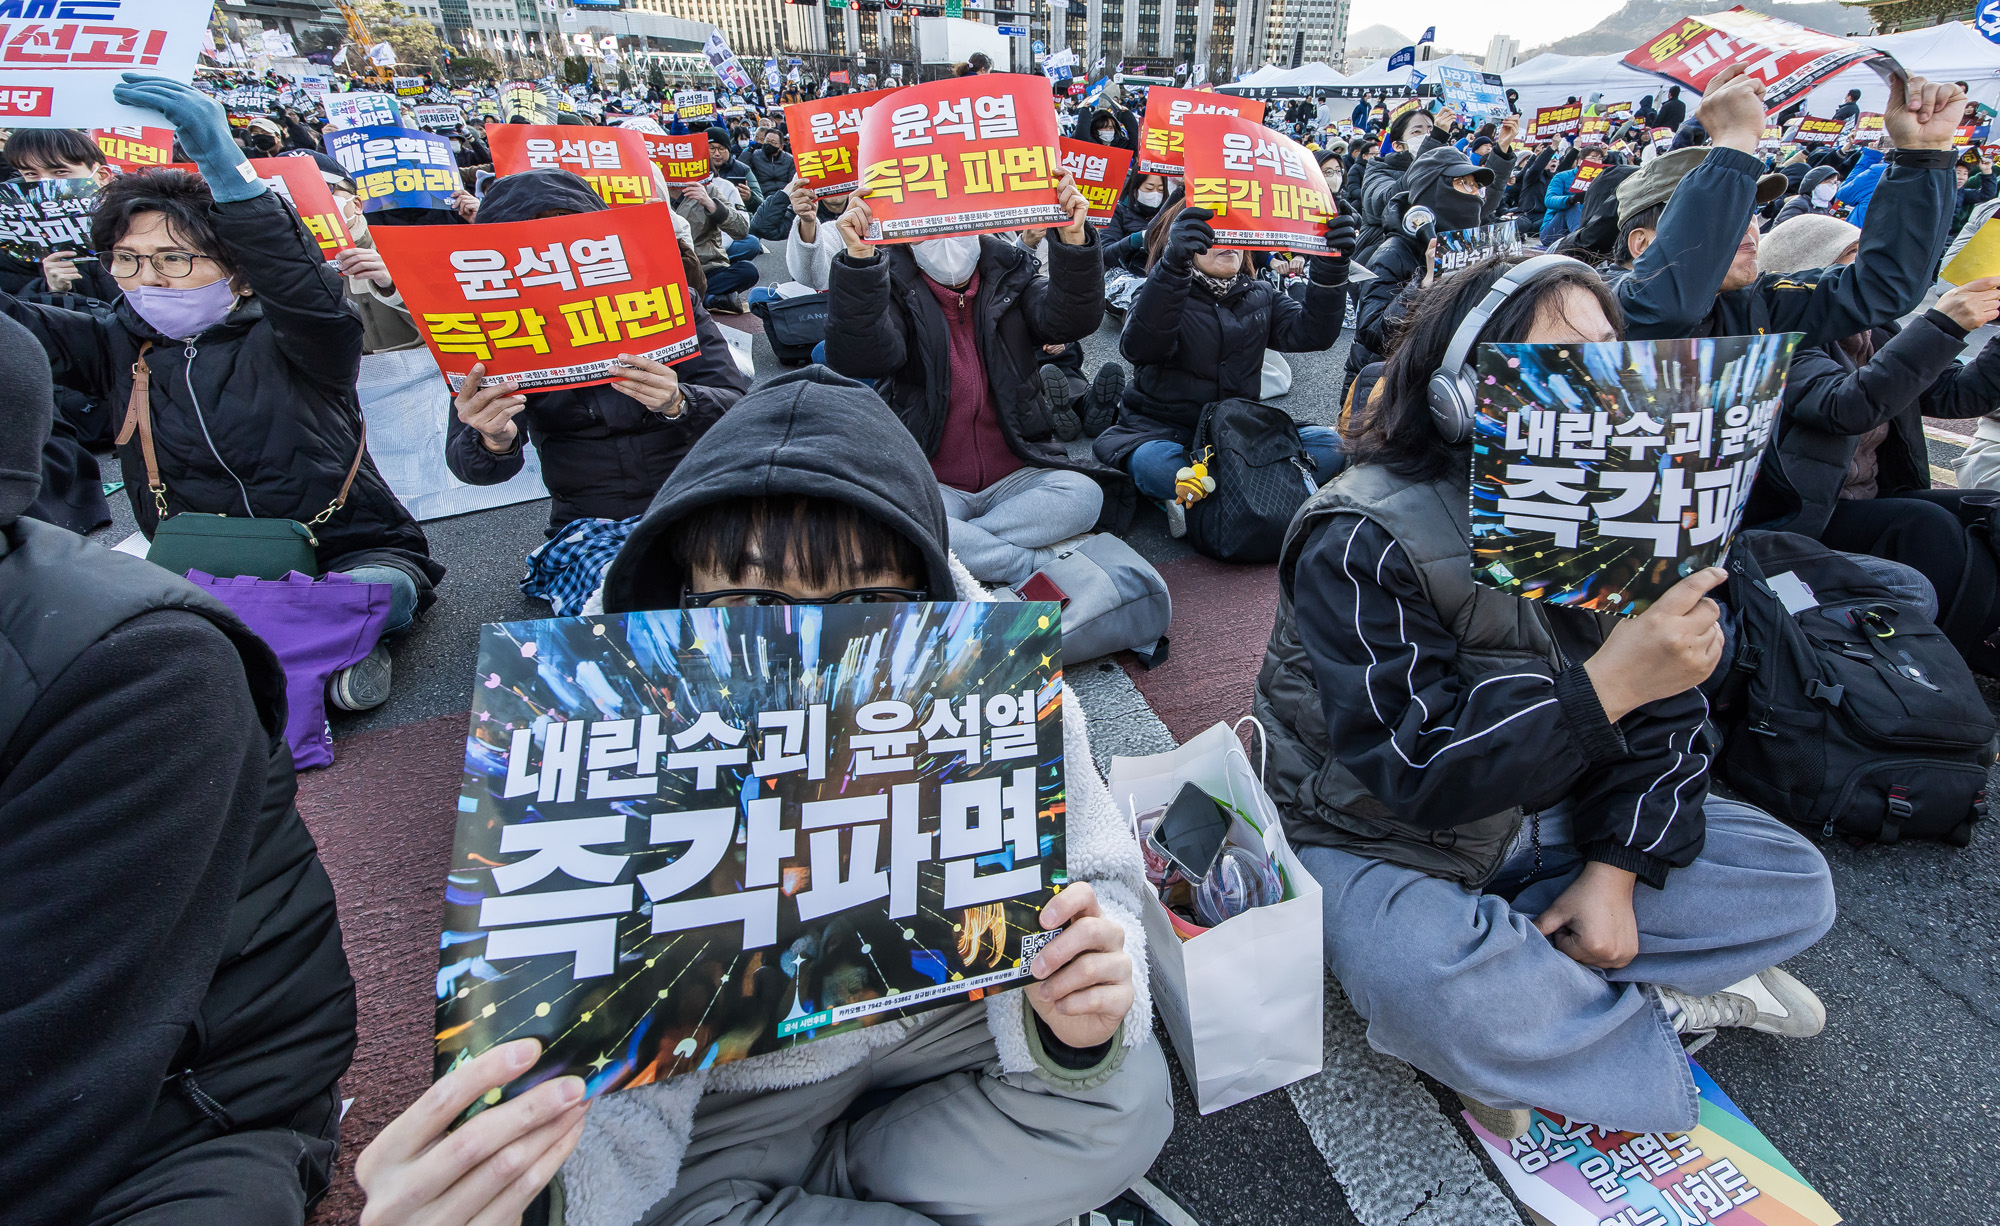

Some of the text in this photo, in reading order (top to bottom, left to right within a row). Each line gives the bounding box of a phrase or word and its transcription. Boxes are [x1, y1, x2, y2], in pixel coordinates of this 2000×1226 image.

[0, 24, 168, 66] 선고!
[1440, 67, 1472, 82] 나라가
[329, 99, 354, 108] 내란수괴
[330, 106, 357, 117] 윤석열
[355, 95, 390, 112] 즉각
[361, 109, 395, 126] 파면
[419, 113, 459, 124] 해체하라
[891, 94, 1019, 149] 윤석열
[332, 132, 369, 149] 한덕수는
[810, 107, 865, 144] 윤석
[525, 138, 622, 170] 윤석열
[669, 158, 708, 179] 파면!
[797, 146, 853, 180] 즉각
[1059, 151, 1109, 183] 석열
[1222, 133, 1308, 182] 윤석열
[863, 146, 1059, 203] 즉각 파면!
[1193, 177, 1336, 226] 즉각 파면!
[450, 235, 632, 300] 윤석열
[422, 283, 686, 361] 즉각 파면!
[506, 373, 523, 382] 파면
[524, 370, 549, 380] 국힘당
[550, 368, 566, 377] 해산
[655, 345, 677, 358] 모이자!
[1505, 398, 1775, 461] 내란수괴 윤석열
[1497, 448, 1765, 558] 즉각파면
[503, 689, 1039, 803] 내란수괴 윤석열
[478, 767, 1043, 981] 즉각파면
[799, 1013, 827, 1028] 시민후원
[838, 1005, 867, 1017] 카카오뱅크
[1579, 1132, 1704, 1204] 윤석열도
[1659, 1157, 1762, 1226] 사회로
